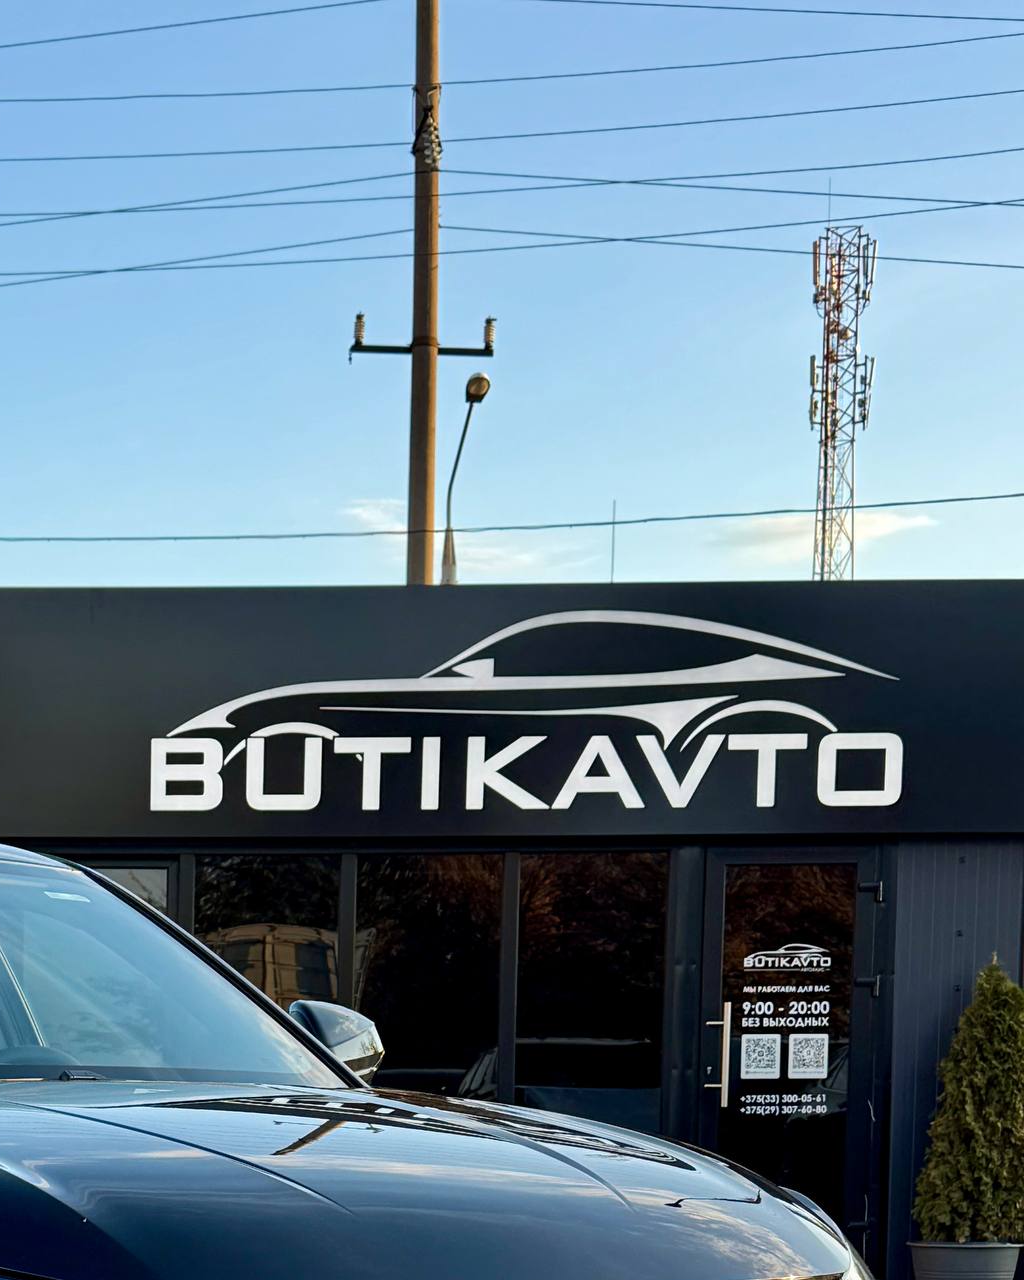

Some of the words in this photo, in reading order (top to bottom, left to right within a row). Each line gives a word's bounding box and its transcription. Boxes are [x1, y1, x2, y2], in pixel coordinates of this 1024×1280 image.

[149, 731, 904, 812] BUTIKAVTO
[743, 956, 832, 968] BUTIKAVTO
[742, 986, 757, 994] МЫ
[757, 985, 796, 993] РАБОТАЕМ
[797, 985, 813, 993] ДЛЯ
[814, 984, 831, 993] ВАС
[742, 1001, 774, 1015] 9:00
[788, 1000, 830, 1015] 20:00
[741, 1018, 760, 1028] БЕЗ
[762, 1017, 830, 1028] ВЫХОДНЫХ
[740, 1094, 780, 1105] +375(33)
[781, 1094, 826, 1103] 300-05-61
[740, 1105, 780, 1116] +375(29)
[781, 1105, 827, 1115] 307-60-80
